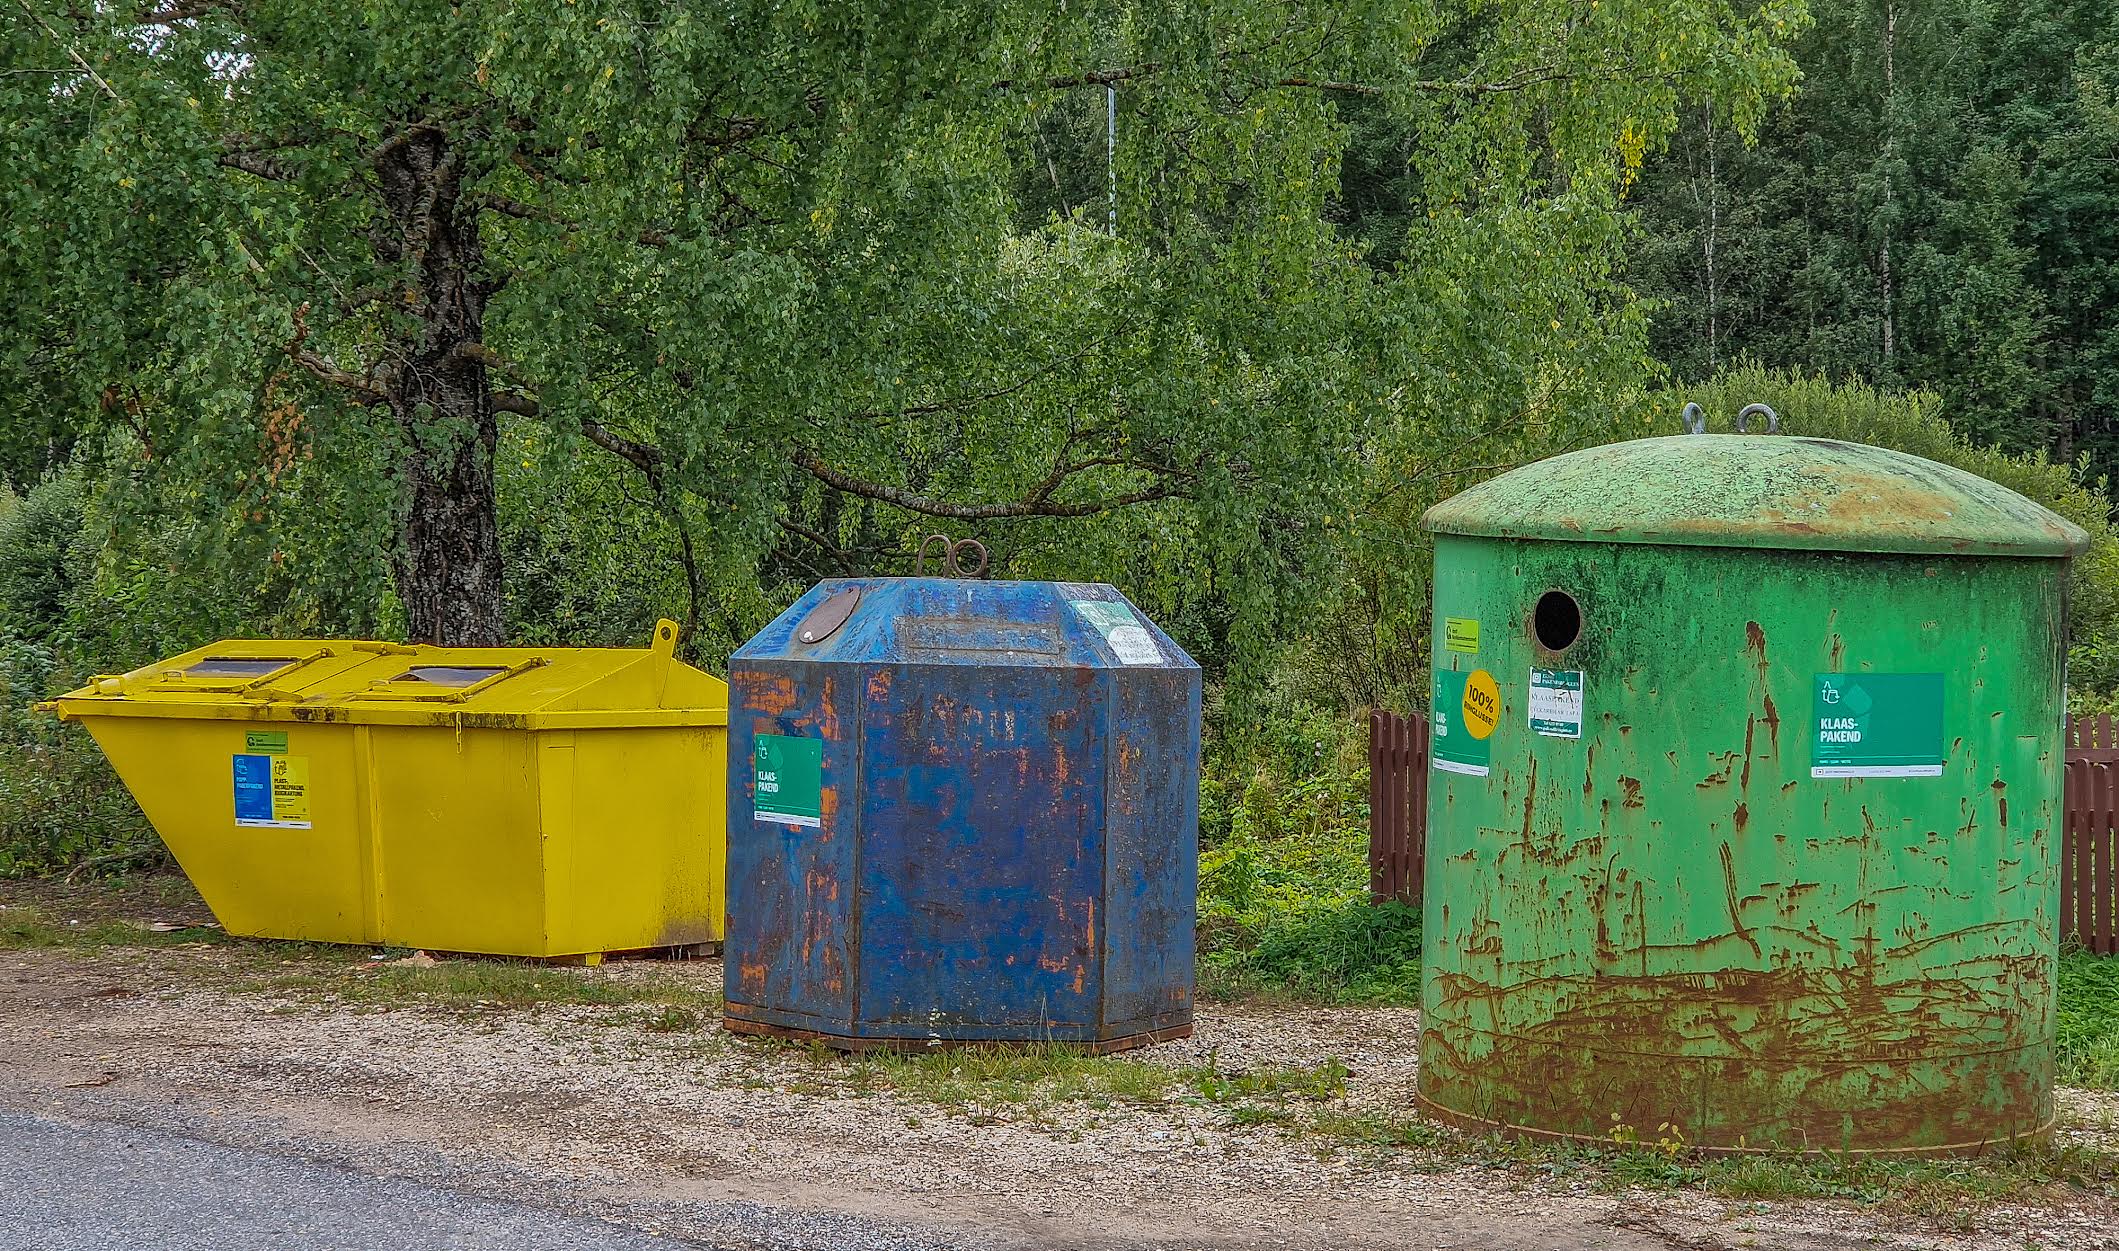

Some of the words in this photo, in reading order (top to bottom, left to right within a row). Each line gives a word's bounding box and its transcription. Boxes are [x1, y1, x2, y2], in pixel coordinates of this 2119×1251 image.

[1468, 684, 1494, 714] 100%
[1820, 718, 1859, 730] KLAAS-
[1820, 731, 1862, 743] PAKEND
[758, 771, 777, 781] KLAAS-
[758, 781, 779, 793] PAKEND
